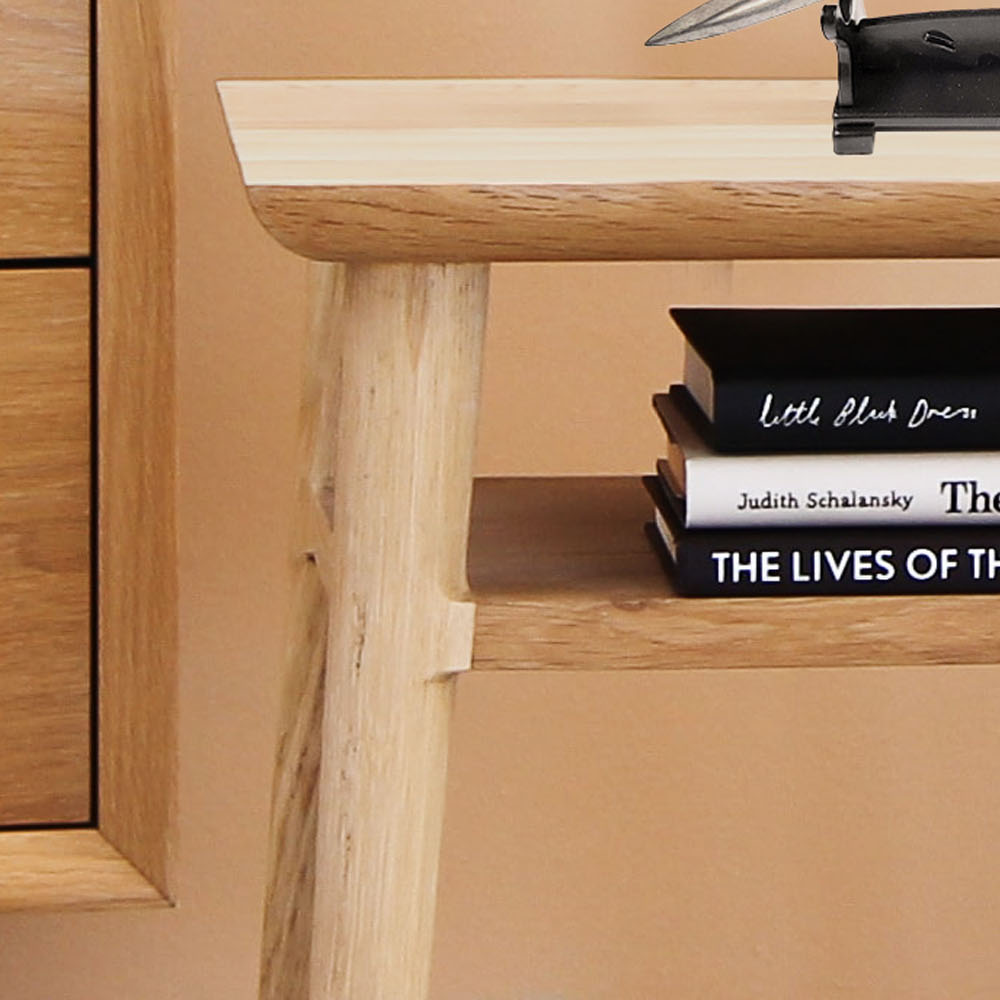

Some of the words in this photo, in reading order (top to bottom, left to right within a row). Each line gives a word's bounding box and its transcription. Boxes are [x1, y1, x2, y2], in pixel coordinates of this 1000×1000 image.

[758, 393, 821, 428] Little
[907, 398, 977, 428] Dress
[737, 491, 800, 512] Judith
[806, 490, 914, 513] Schalansky
[711, 551, 781, 584] THE
[792, 549, 896, 583] LIVES
[906, 548, 958, 580] OF
